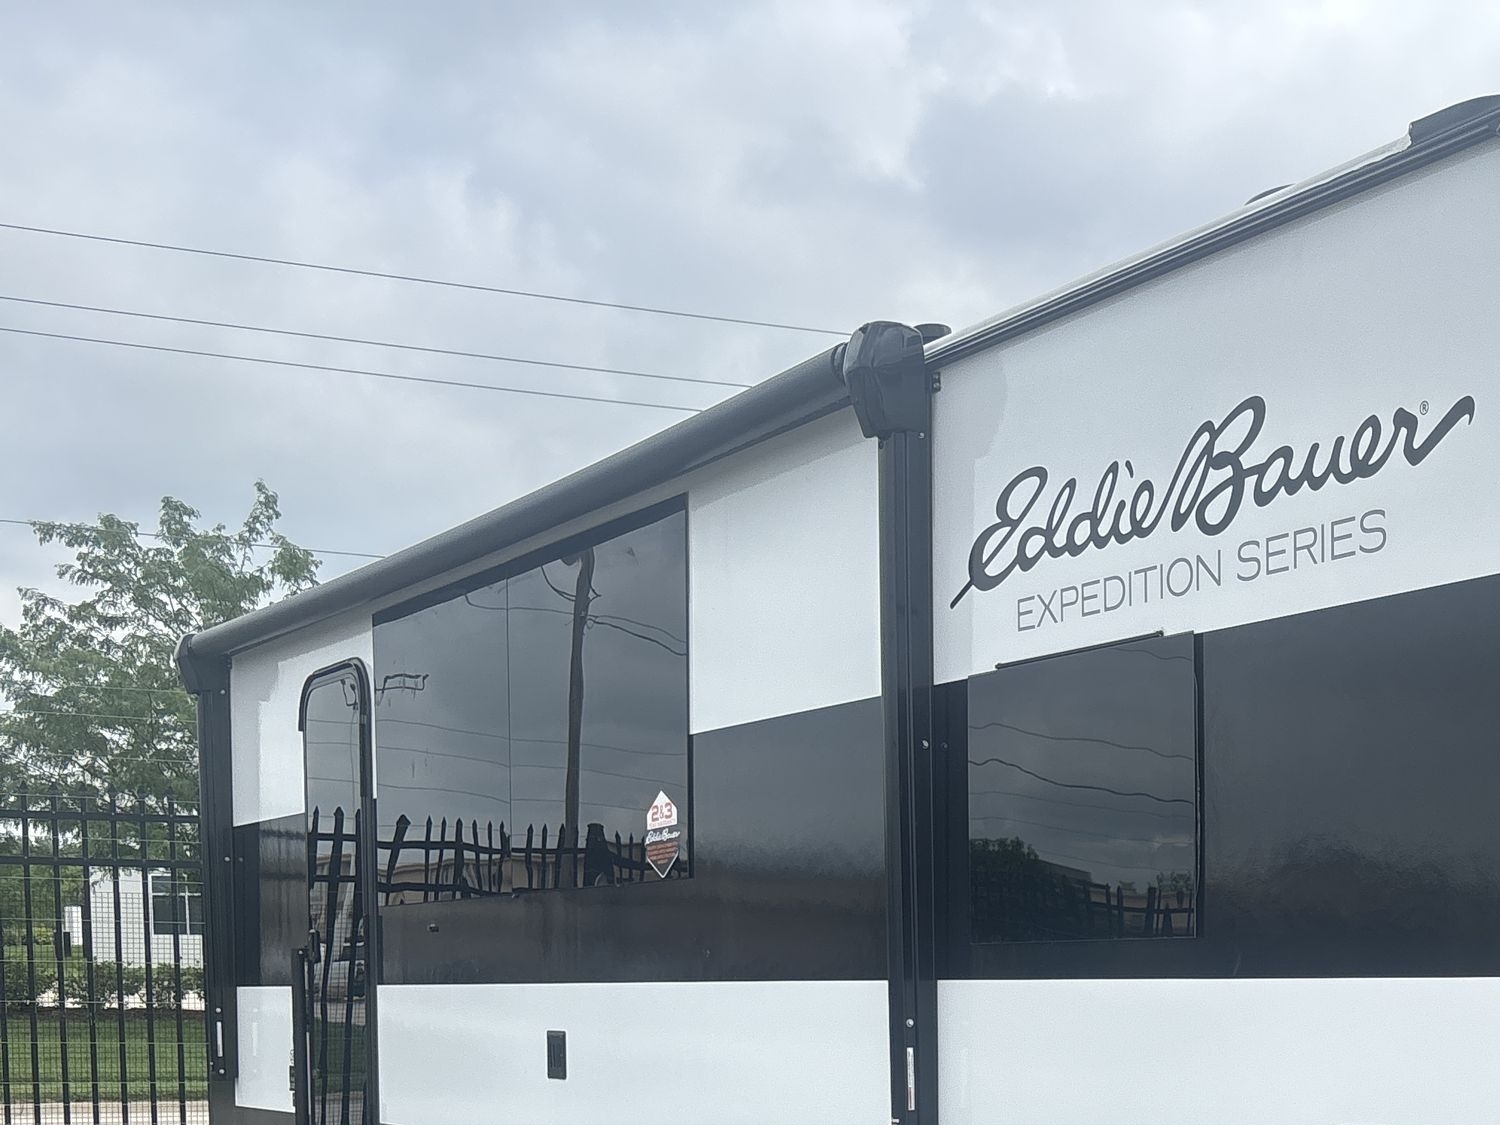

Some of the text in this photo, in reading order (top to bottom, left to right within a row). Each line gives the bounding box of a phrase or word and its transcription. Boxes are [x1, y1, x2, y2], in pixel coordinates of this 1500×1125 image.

[950, 460, 1160, 609] Eddie
[1017, 509, 1387, 632] EXPEDITION SERIES
